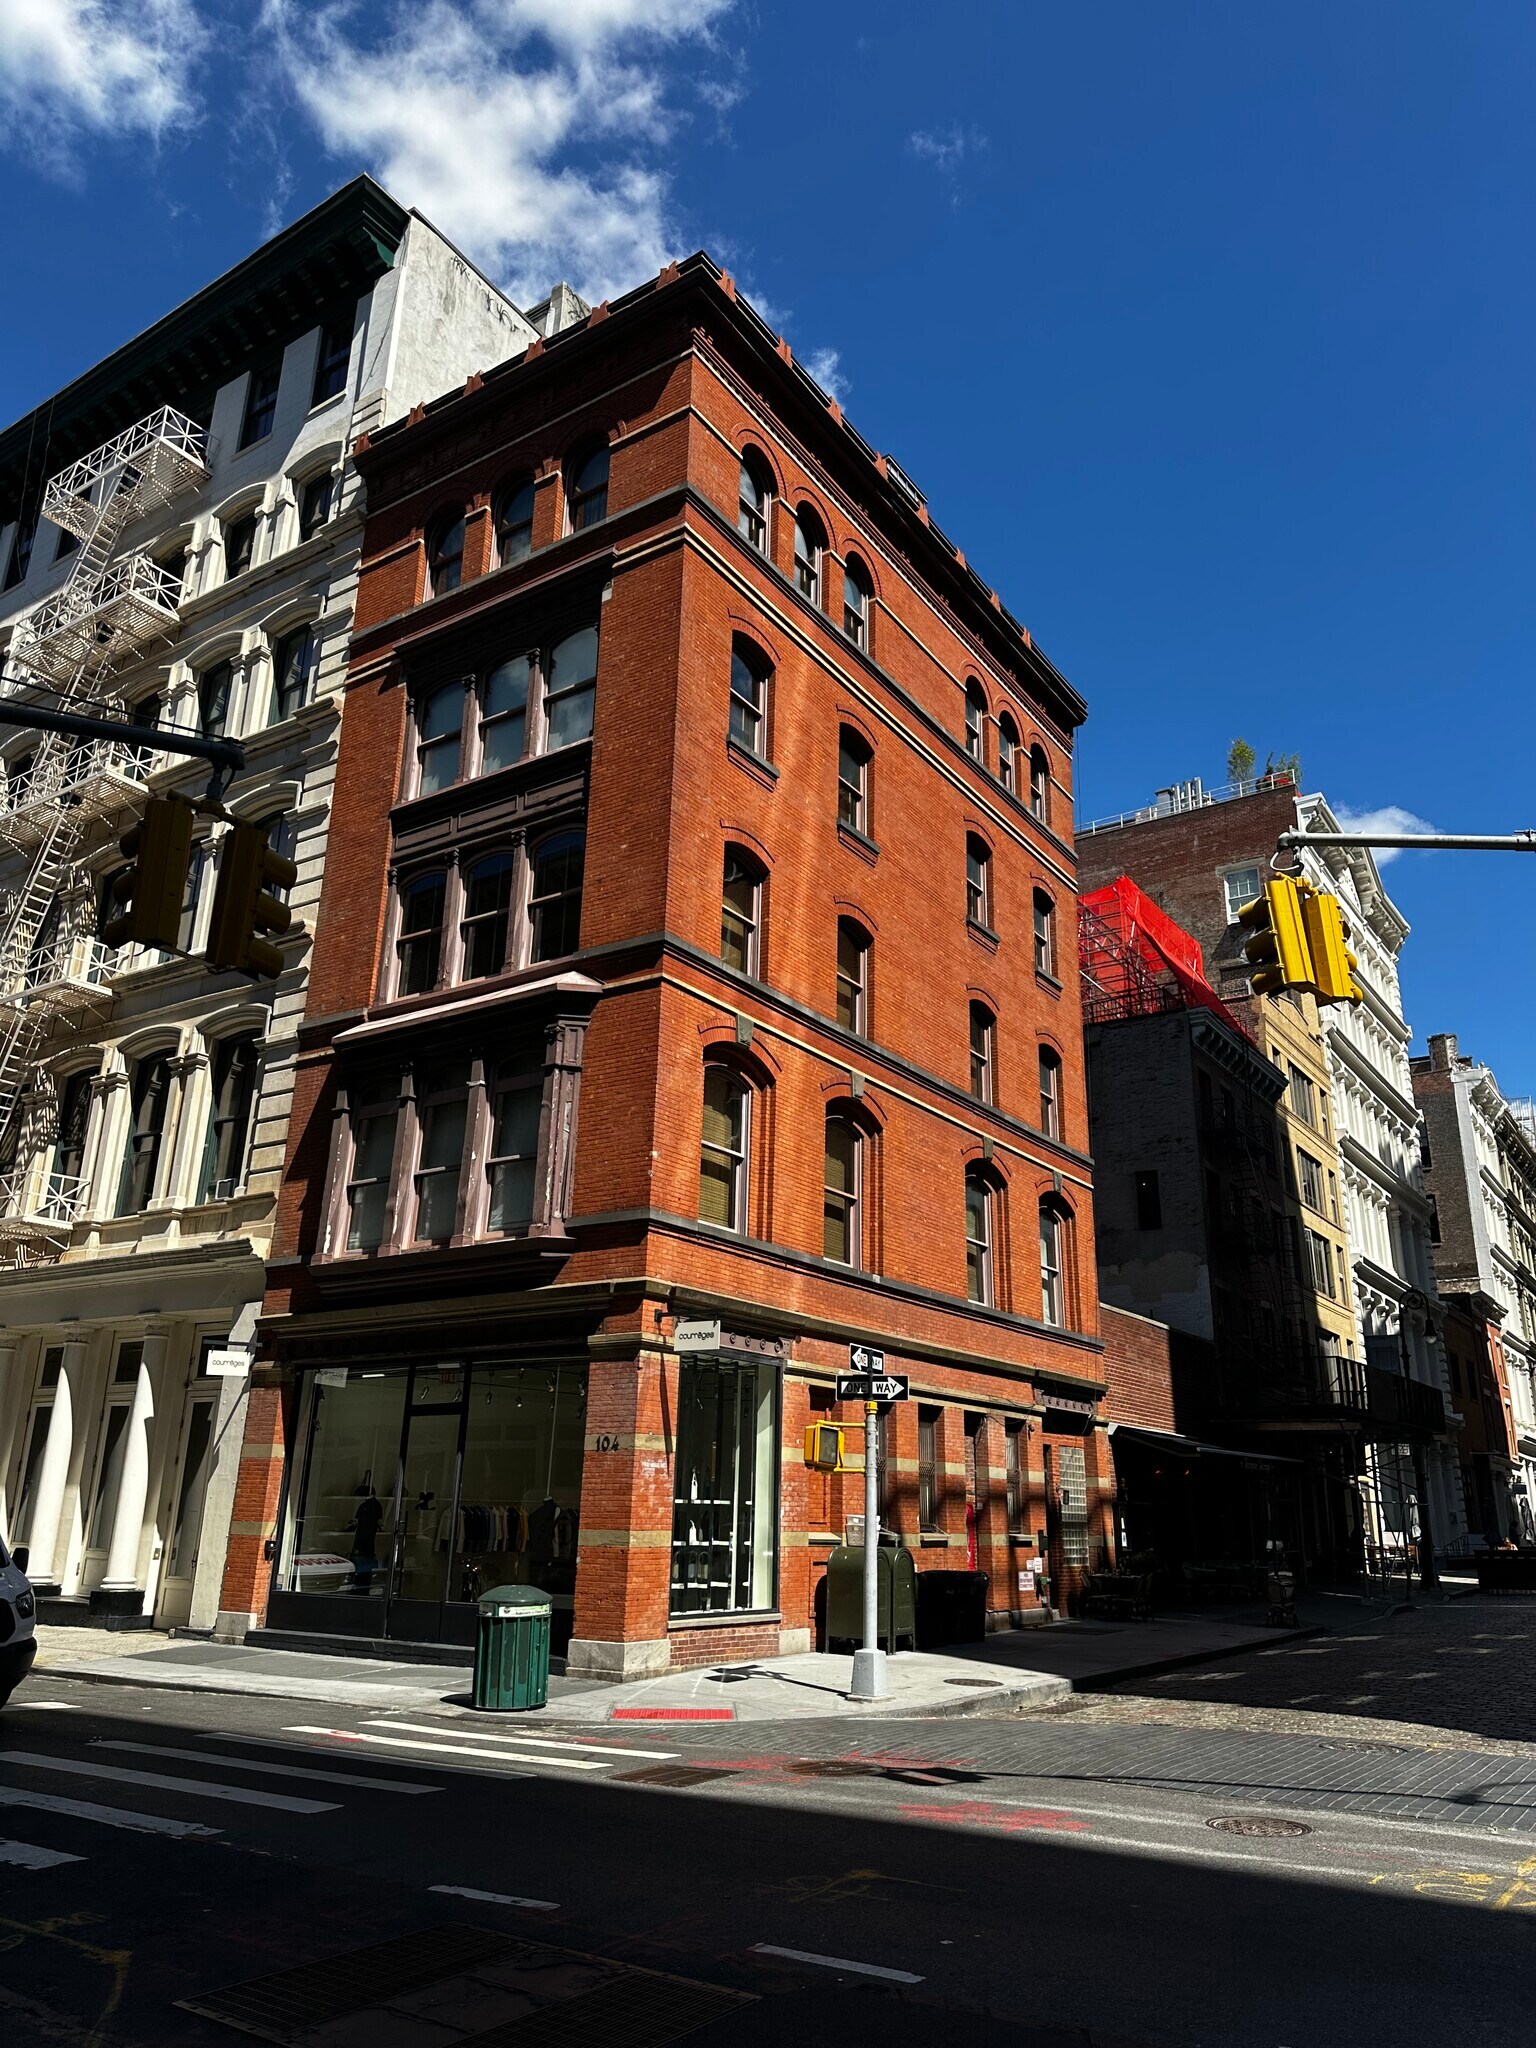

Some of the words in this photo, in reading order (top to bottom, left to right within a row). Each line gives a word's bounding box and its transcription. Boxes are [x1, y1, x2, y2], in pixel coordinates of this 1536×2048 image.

[857, 1354, 867, 1365] ONE
[847, 1383, 867, 1392] ONE
[876, 1383, 897, 1393] WAY
[596, 1435, 619, 1452] 104
